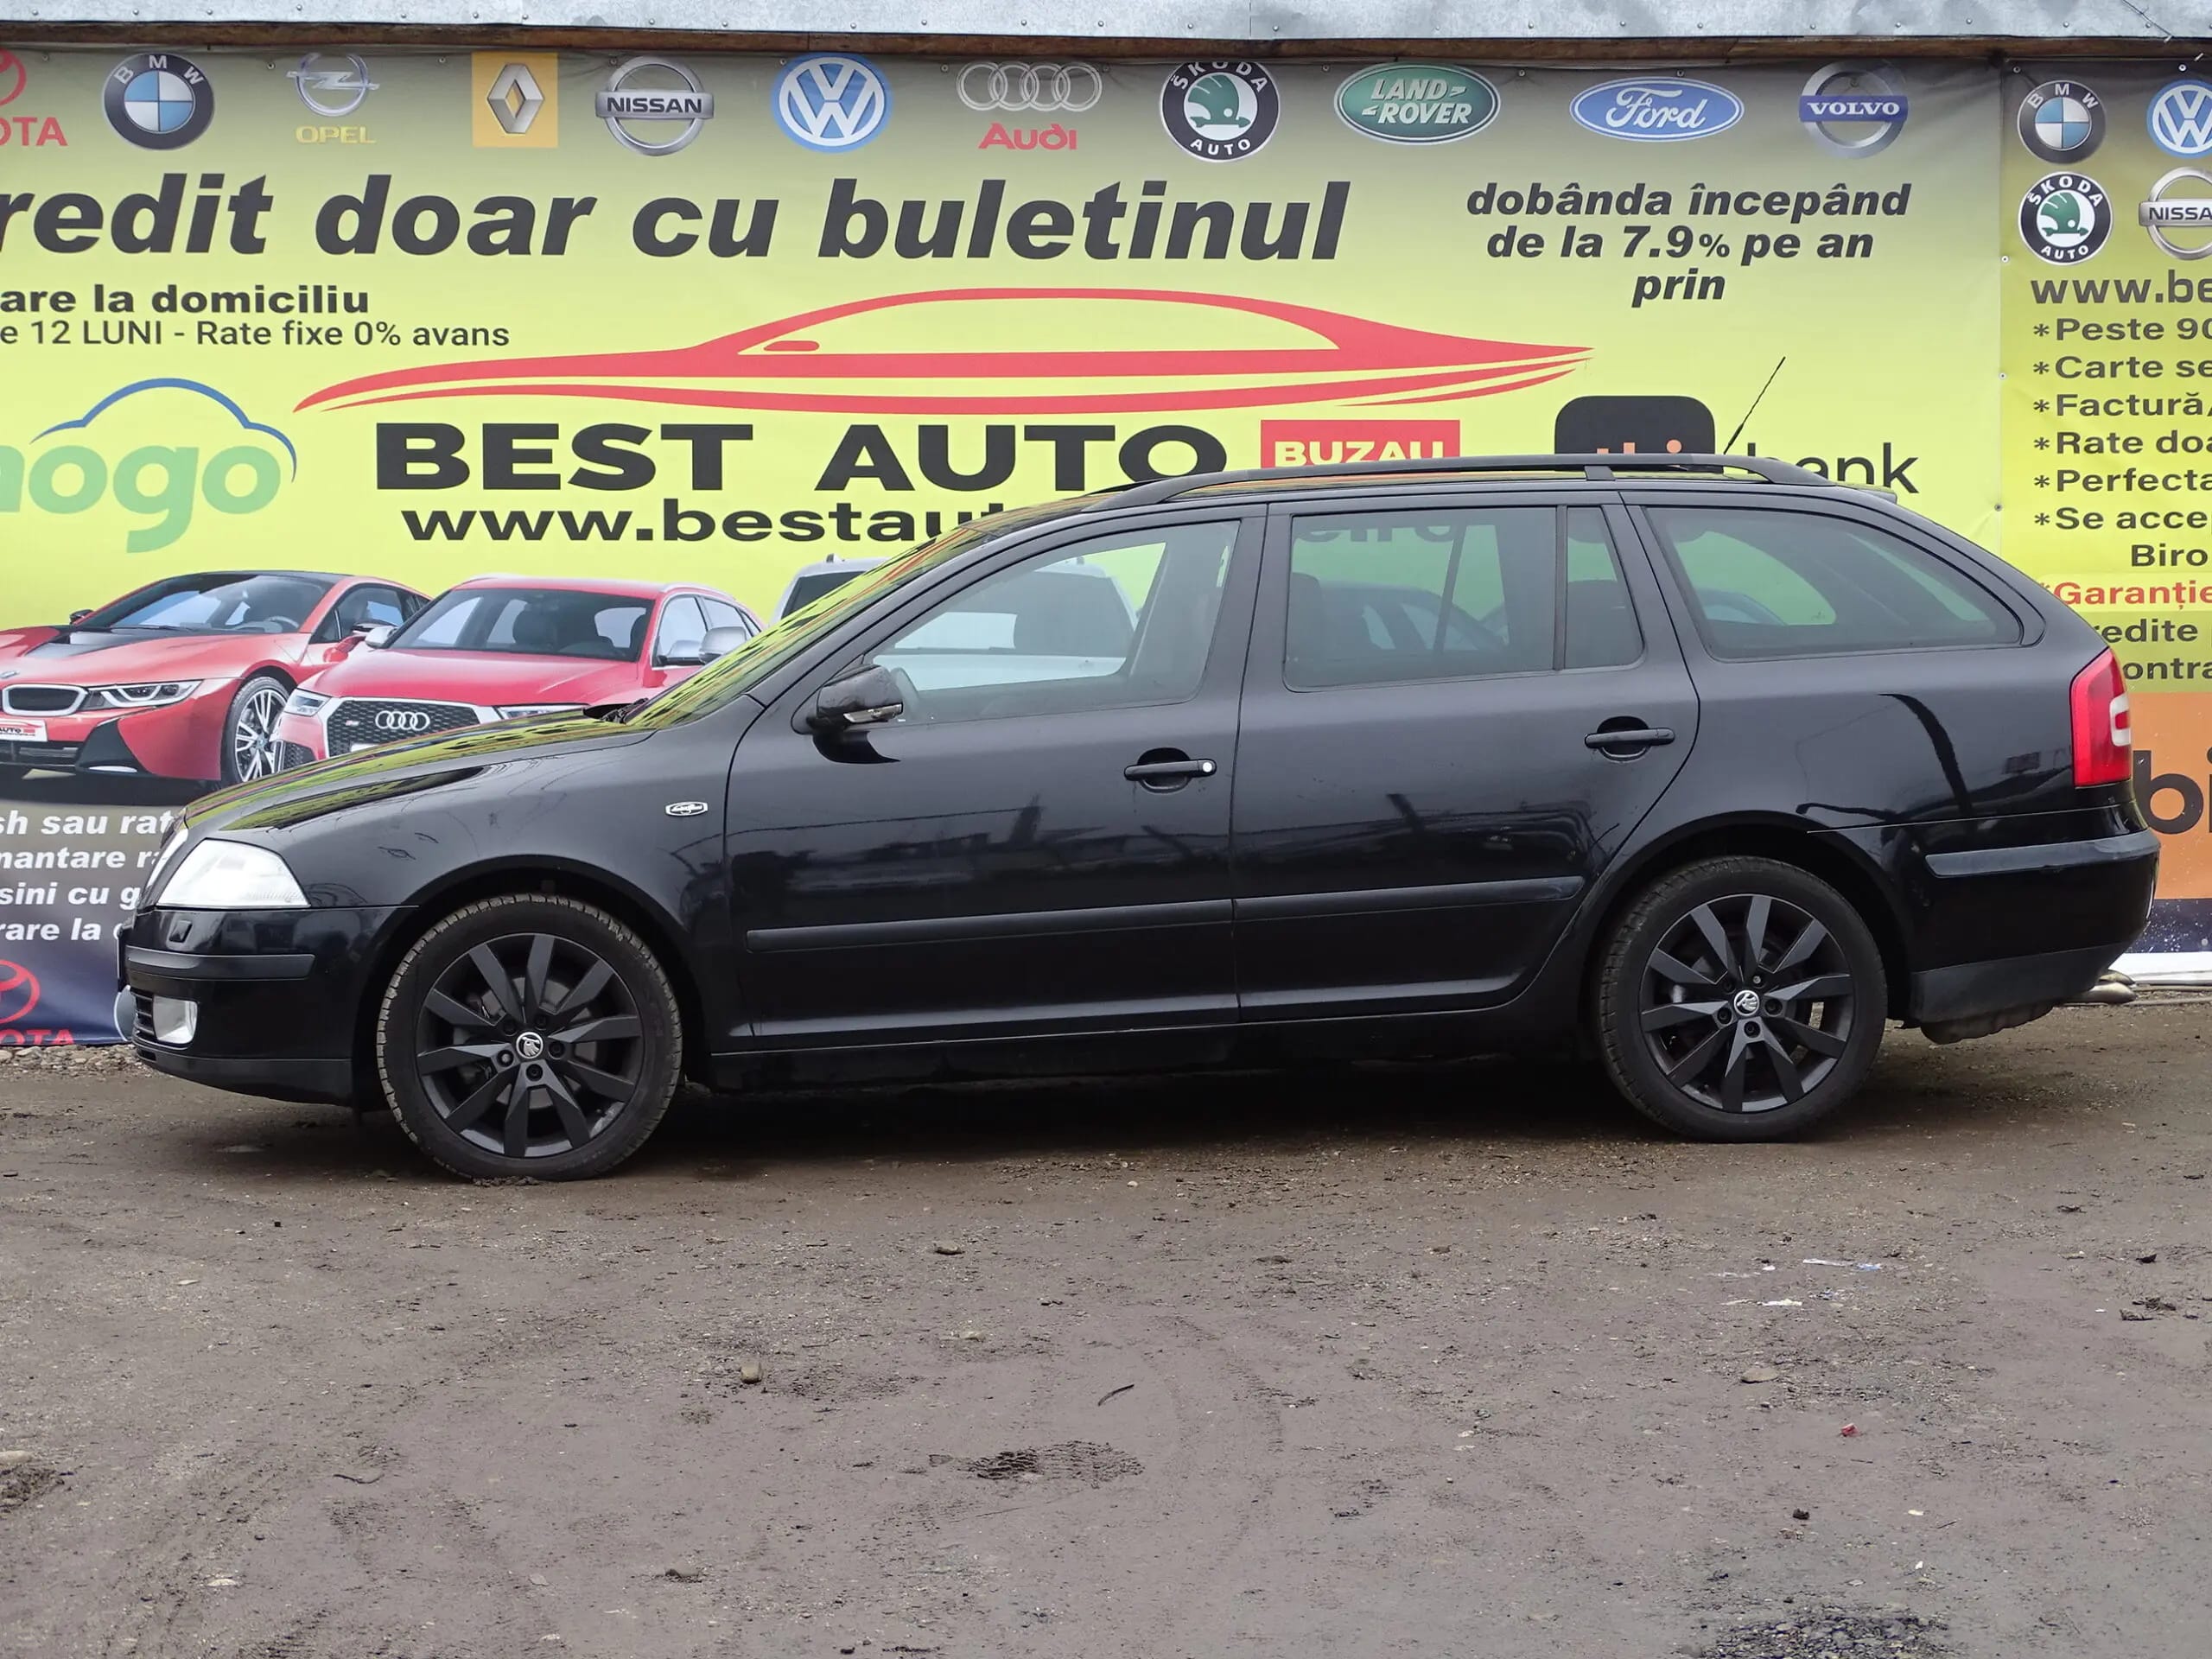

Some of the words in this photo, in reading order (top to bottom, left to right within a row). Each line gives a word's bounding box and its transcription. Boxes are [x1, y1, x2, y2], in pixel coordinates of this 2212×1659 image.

[113, 54, 203, 84] BMW
[1370, 79, 1448, 100] LAND
[2027, 83, 2099, 109] BMW
[607, 97, 702, 114] NISSAN
[1377, 102, 1472, 124] ROVER
[1605, 86, 1710, 129] Ford
[1807, 100, 1900, 116] VOLVO
[295, 125, 378, 145] OPEL
[978, 123, 1077, 150] Audi
[1191, 138, 1251, 156] AUTO
[1467, 182, 1673, 216] dobânda
[1688, 182, 1912, 224] începând
[315, 175, 597, 257] doar
[632, 197, 779, 258] cu
[818, 178, 1351, 260] buletinul
[1486, 226, 1544, 258] de
[1560, 226, 1604, 258] la
[1740, 232, 1801, 266] pe
[1817, 233, 1874, 258] an
[2042, 245, 2089, 259] AUTO
[0, 290, 77, 313] are
[93, 283, 135, 313] la
[151, 284, 369, 314] domiciliu
[1631, 268, 1726, 308] prin
[0, 325, 19, 344] e
[31, 320, 72, 345] 12
[83, 320, 162, 345] LUNI
[196, 320, 271, 345] Rate
[282, 319, 343, 346] fixe
[353, 320, 402, 346] 0%
[411, 326, 511, 346] avans
[377, 423, 753, 492] BEST
[814, 424, 1227, 492] AUTO
[2130, 543, 2209, 567] Biro
[41, 813, 108, 836] sau
[67, 886, 110, 906] cu
[70, 918, 101, 942] la
